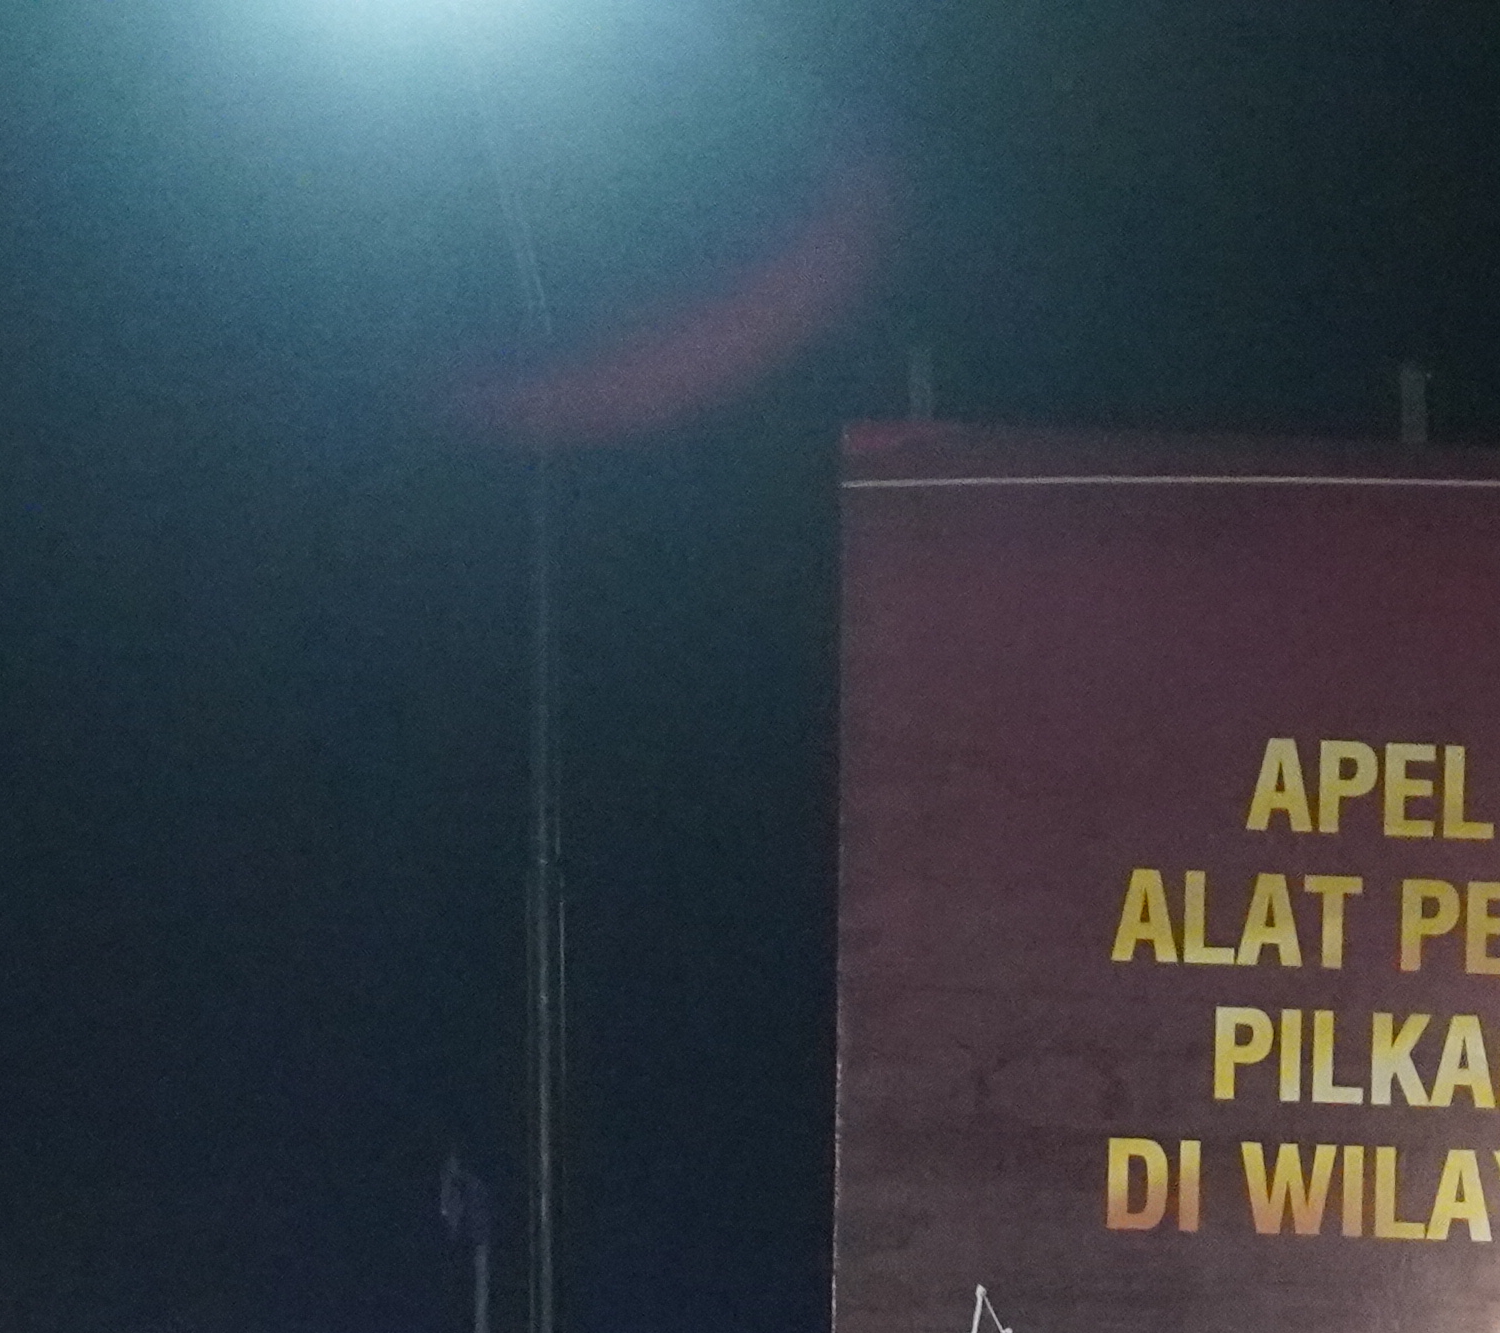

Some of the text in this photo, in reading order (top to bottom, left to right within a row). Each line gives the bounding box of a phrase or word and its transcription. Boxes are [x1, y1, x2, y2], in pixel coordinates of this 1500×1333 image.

[1246, 737, 1494, 840] APEL
[1111, 868, 1363, 970] ALAT
[1106, 1137, 1201, 1232] DI
